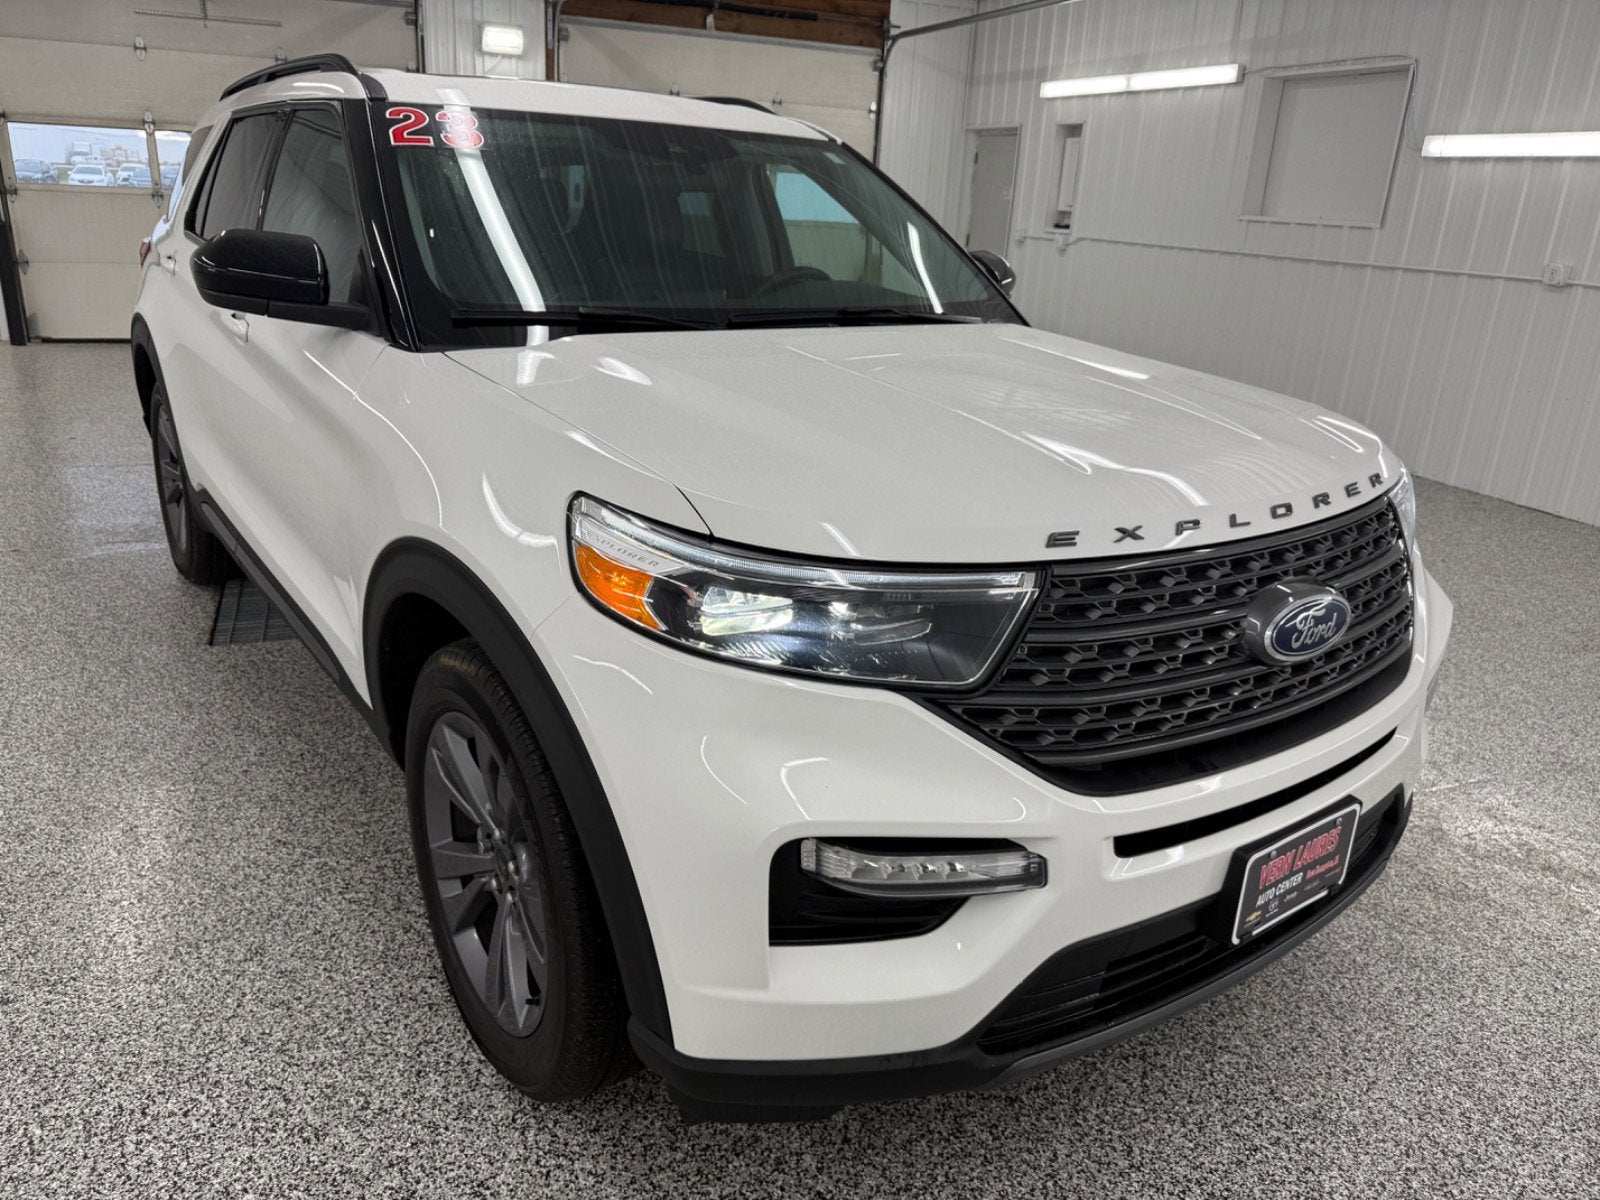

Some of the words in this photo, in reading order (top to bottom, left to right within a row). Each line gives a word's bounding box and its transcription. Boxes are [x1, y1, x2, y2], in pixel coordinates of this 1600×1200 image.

[385, 106, 484, 149] 23
[1045, 472, 1385, 549] EXPLORER
[1285, 607, 1338, 649] Ford
[1255, 888, 1275, 908] AUTO
[1275, 872, 1303, 895] CENTER
[1259, 849, 1295, 889] VERN
